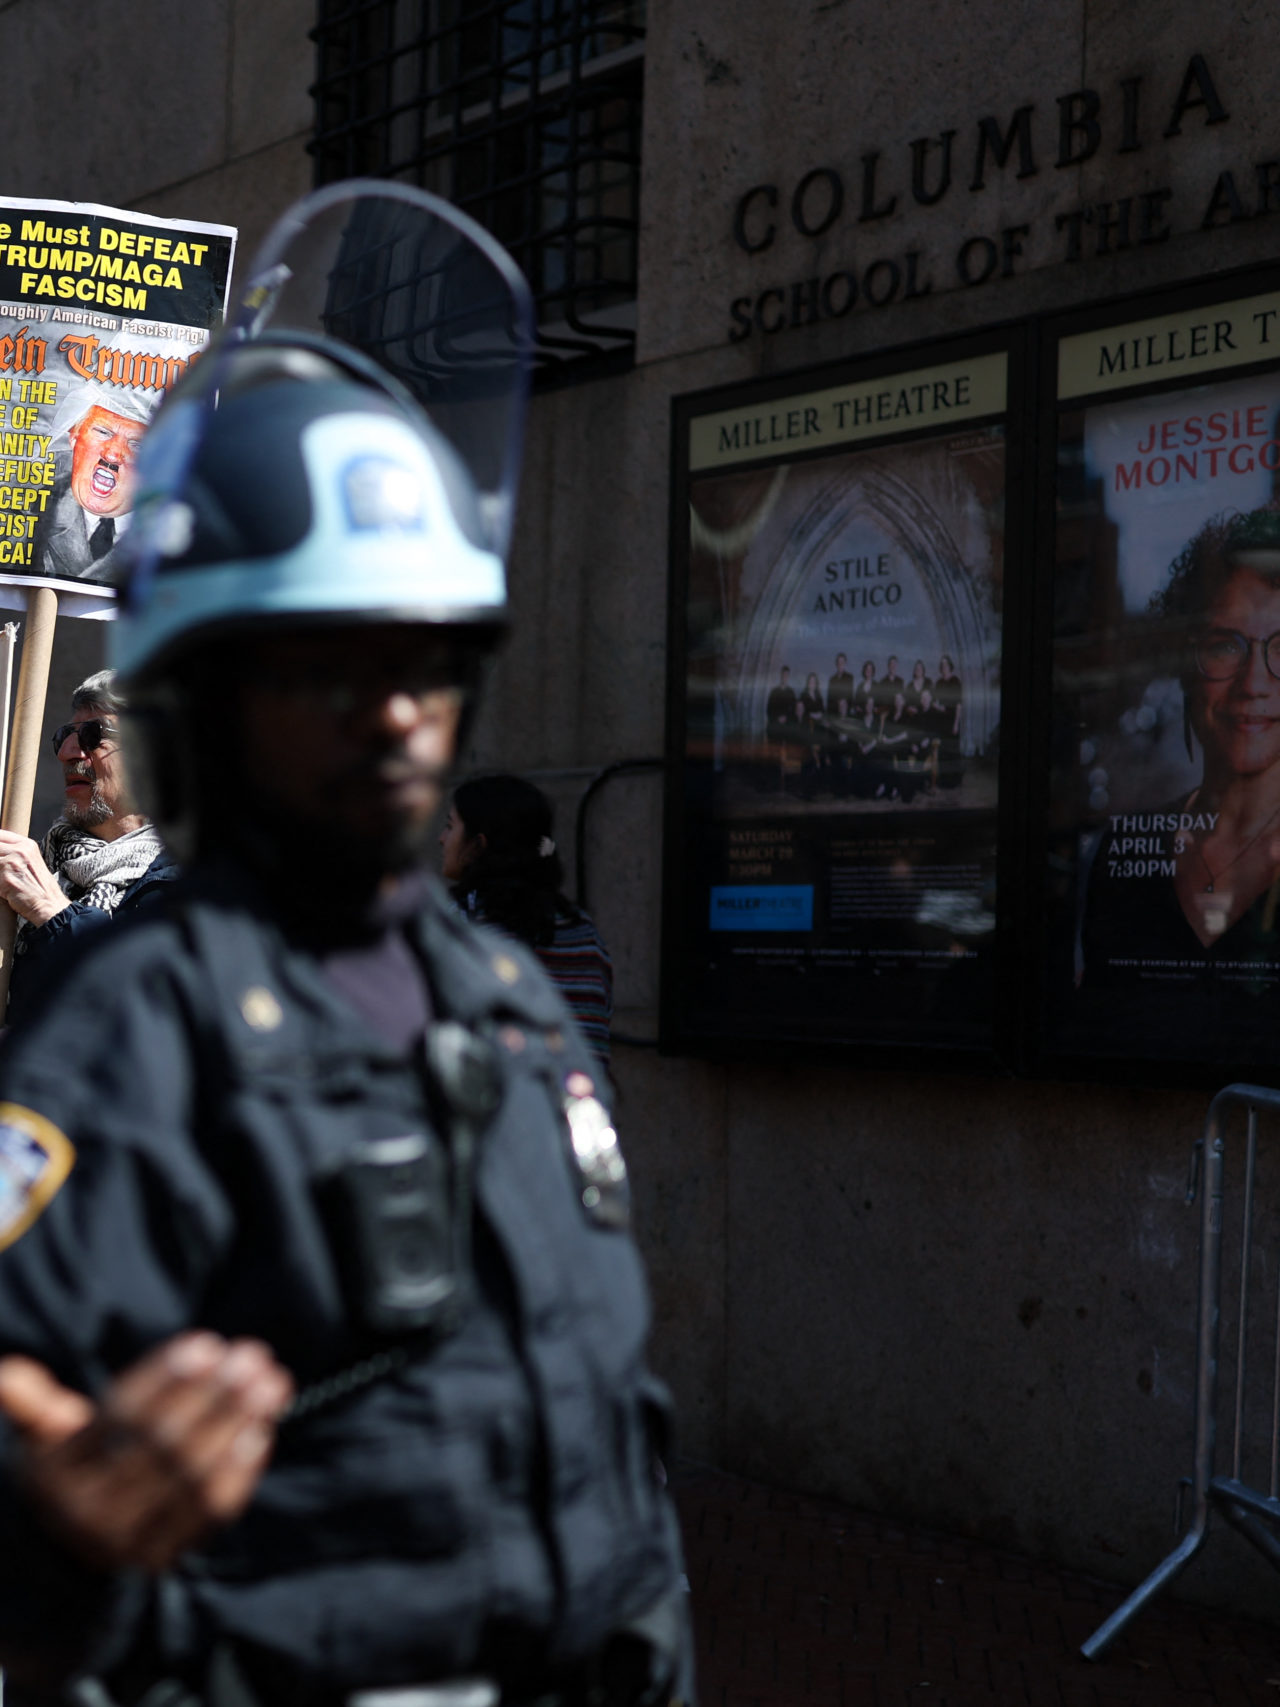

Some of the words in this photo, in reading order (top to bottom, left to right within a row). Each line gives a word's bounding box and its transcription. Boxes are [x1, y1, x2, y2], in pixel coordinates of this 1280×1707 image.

[733, 53, 1230, 256] COLUMBIA
[20, 220, 91, 247] Must
[100, 228, 209, 267] DEFEAT
[728, 251, 933, 344] SCHOOL
[956, 223, 1031, 287] OF
[1055, 186, 1173, 264] THE
[20, 273, 148, 312] FASCISM
[52, 308, 117, 330] American
[122, 320, 172, 338] Fascist
[177, 327, 205, 345] Pig!
[1098, 320, 1238, 377] MILLER
[18, 380, 58, 405] THE
[11, 405, 39, 431] OF
[717, 407, 822, 453] MILLER
[833, 376, 972, 431] THEATRE
[1137, 405, 1269, 454] JESSIE
[825, 553, 891, 583] STILE
[814, 582, 902, 613] ANTICO
[1109, 812, 1220, 832] THURSDAY
[1108, 837, 1165, 856] APRIL
[1174, 837, 1185, 854] 3
[1108, 859, 1177, 878] 7:30PM
